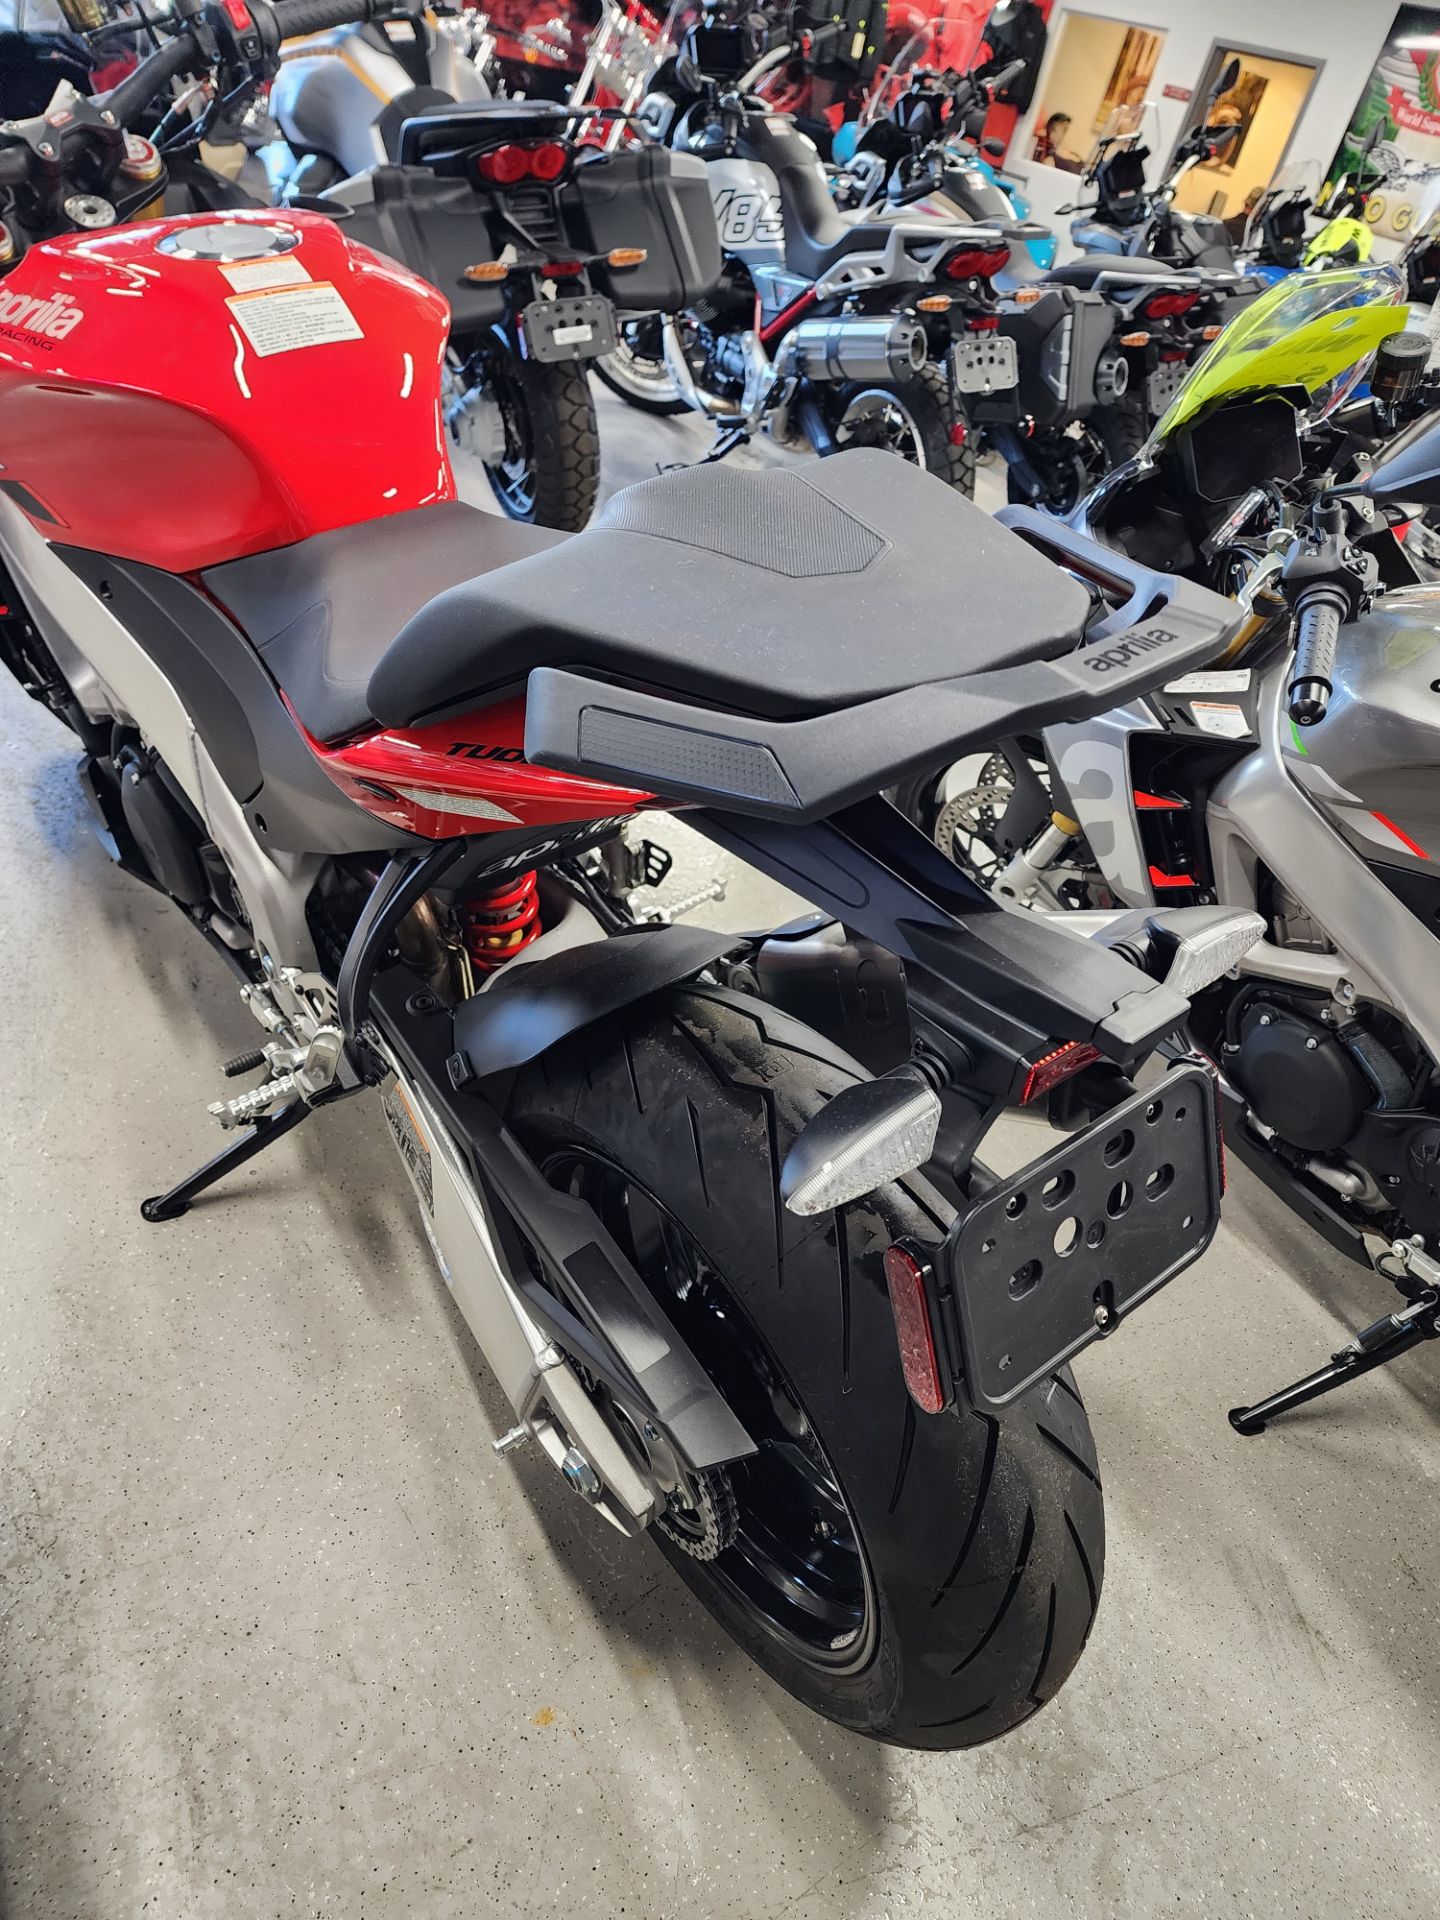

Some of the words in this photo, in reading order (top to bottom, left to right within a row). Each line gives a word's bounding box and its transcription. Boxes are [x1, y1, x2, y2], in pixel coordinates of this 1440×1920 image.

[0, 327, 55, 351] ACING
[1083, 629, 1179, 672] aprilia
[446, 742, 529, 764] TUO
